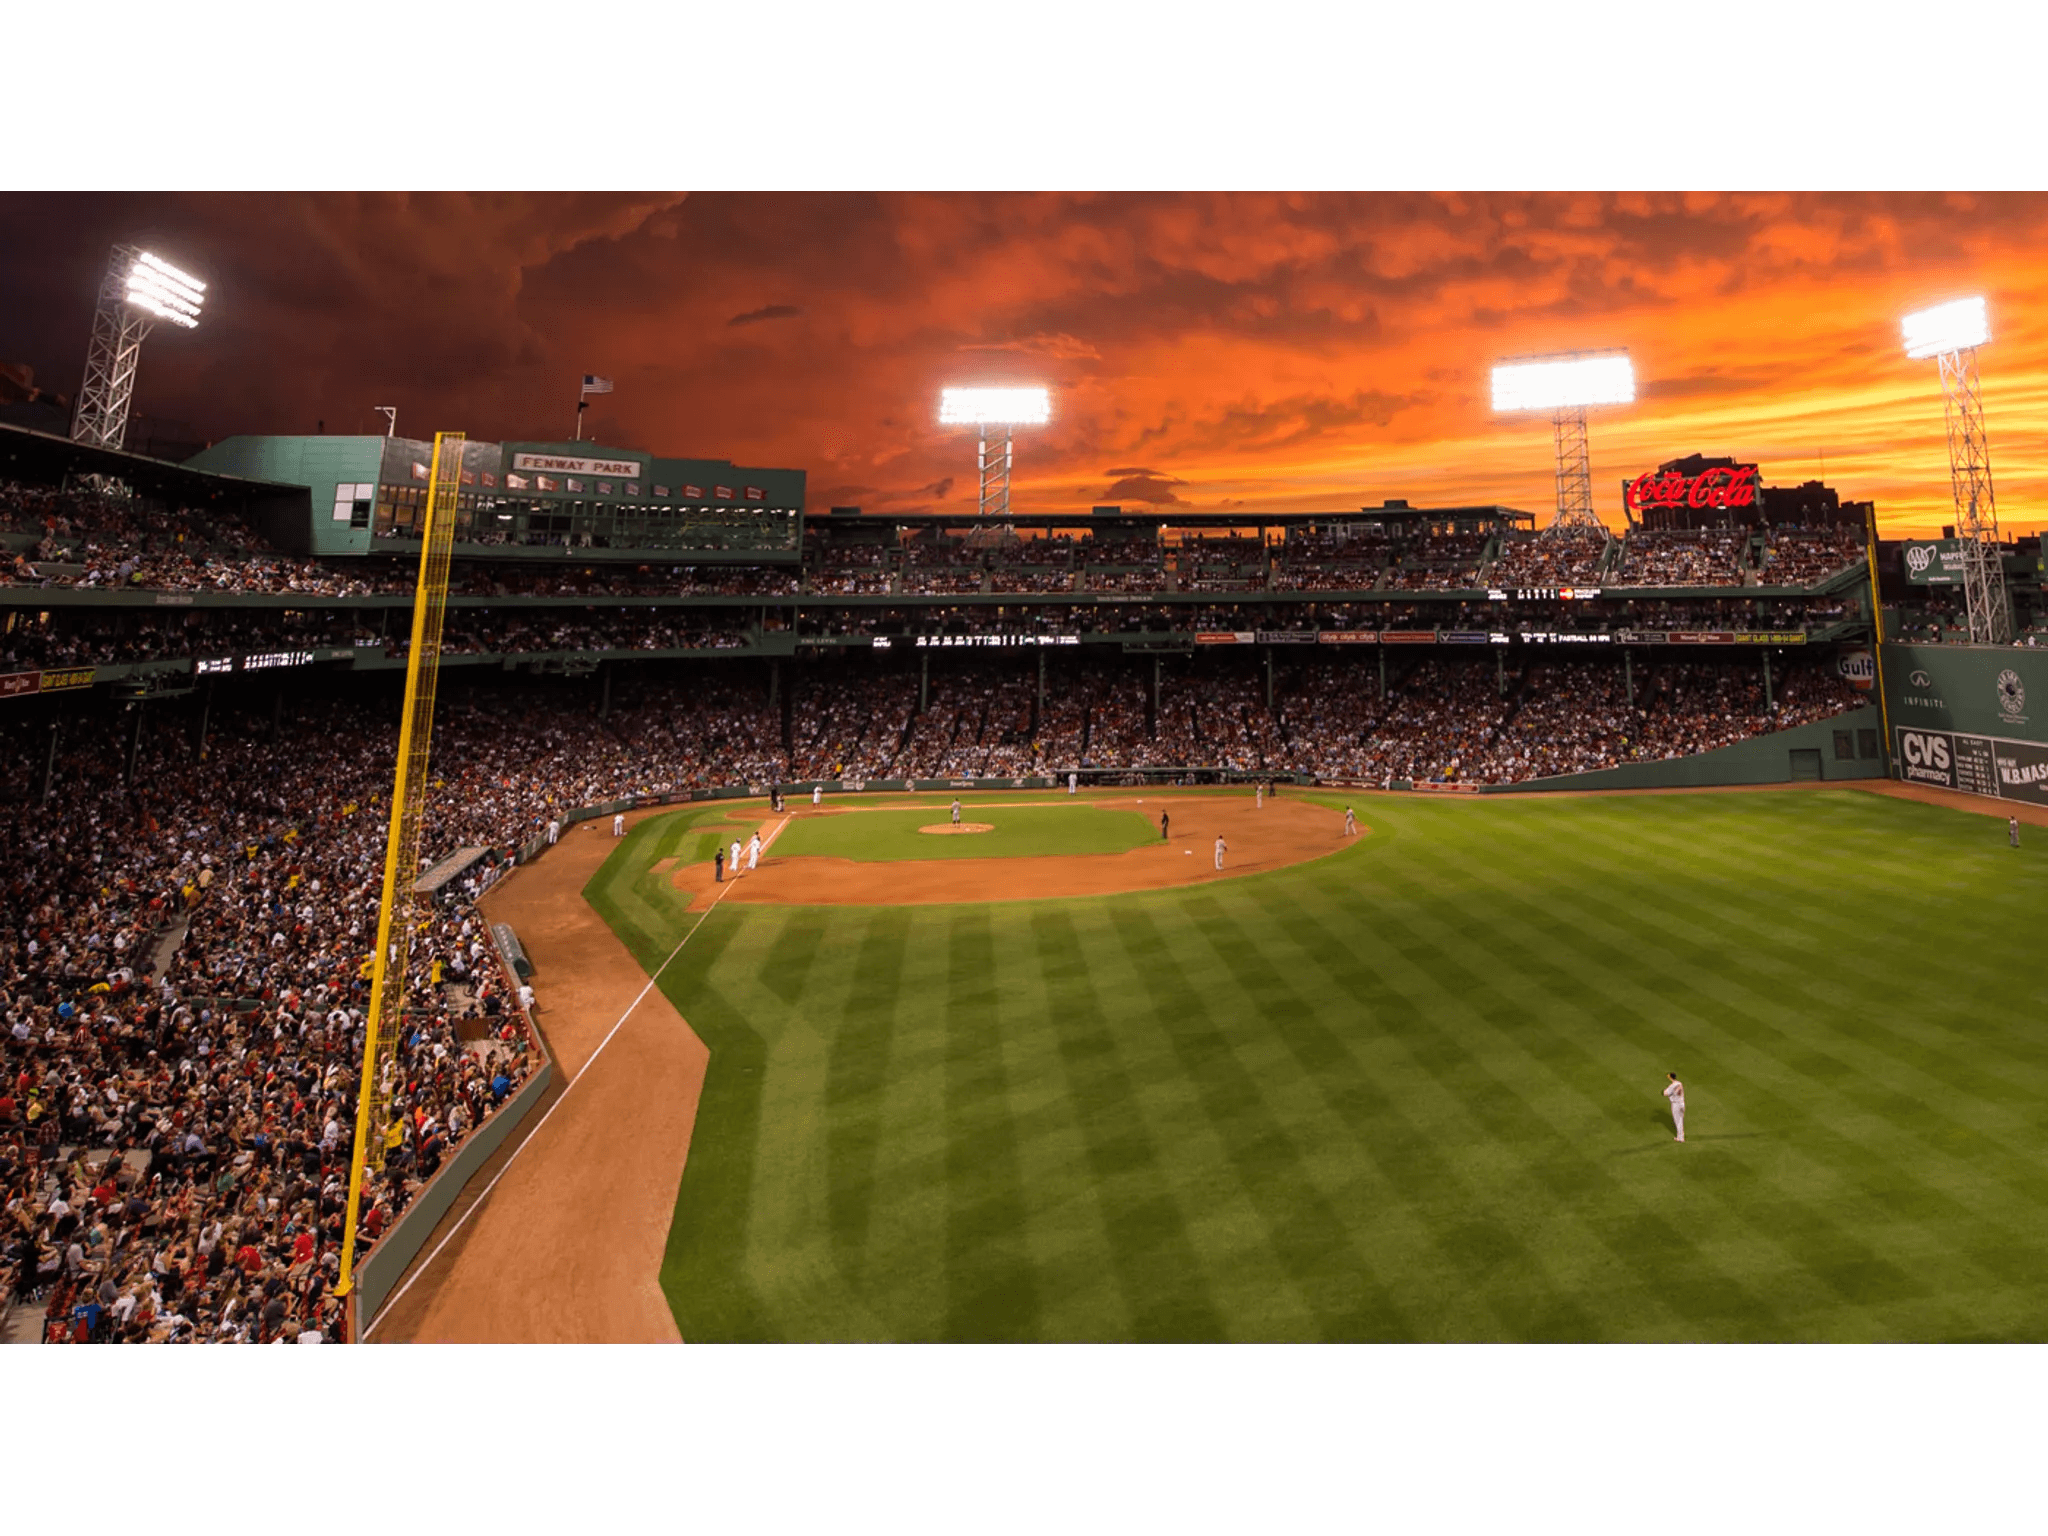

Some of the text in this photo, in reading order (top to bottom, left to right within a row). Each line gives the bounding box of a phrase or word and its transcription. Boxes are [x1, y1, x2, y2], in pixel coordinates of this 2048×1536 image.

[523, 457, 633, 474] FENWAY PARK
[1627, 466, 1758, 510] Coca-Cola
[1839, 656, 1873, 676] Gulf
[1903, 732, 1950, 769] CVS
[1907, 764, 1951, 786] pharmacy
[2001, 763, 2048, 784] W.B.MAS
